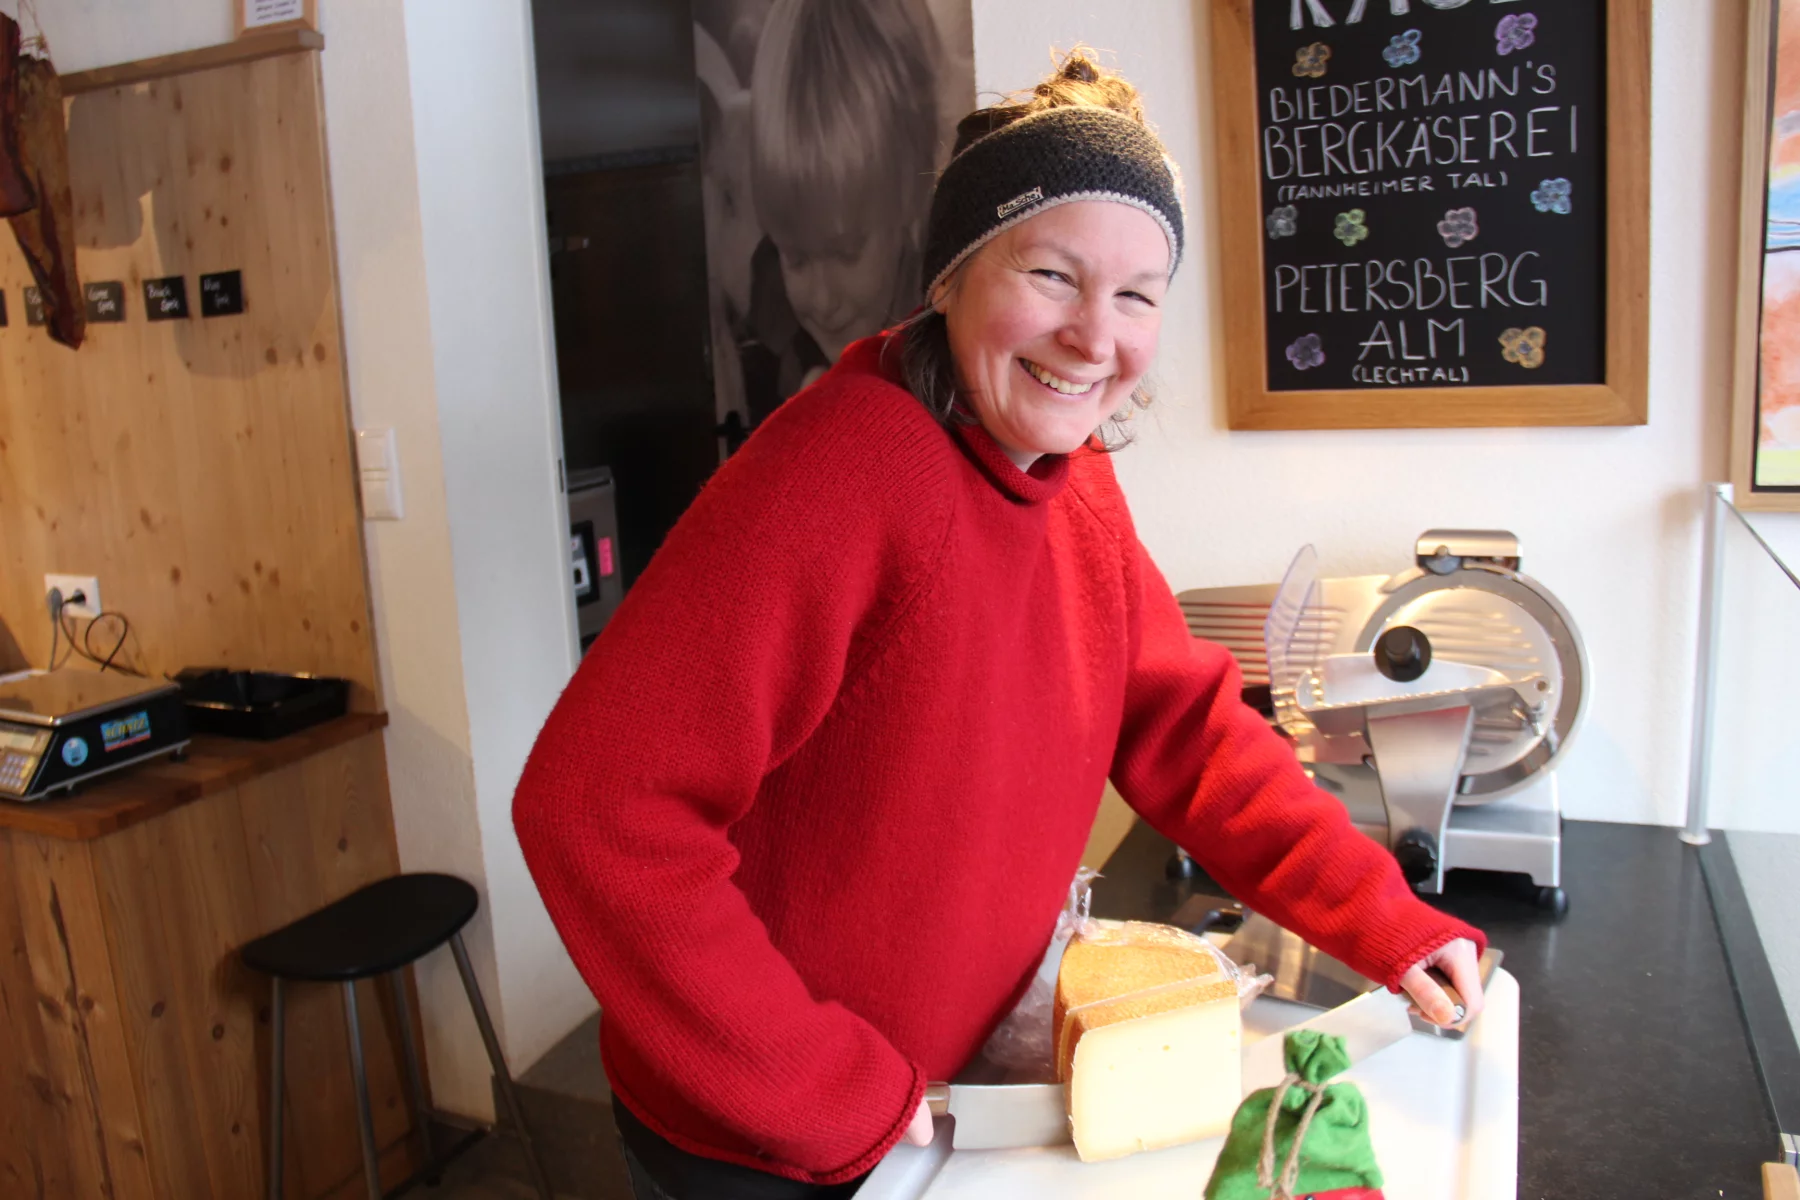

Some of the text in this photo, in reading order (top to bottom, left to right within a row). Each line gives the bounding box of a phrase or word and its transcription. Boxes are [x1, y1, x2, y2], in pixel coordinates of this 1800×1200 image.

[1269, 61, 1557, 123] BIEDERMANN'S
[1264, 105, 1578, 180] BERGKÄSEREI
[1278, 171, 1509, 202] (TANNHEIMER TAL)
[1274, 251, 1549, 313] PETERSBERG
[1358, 318, 1466, 361] ALM
[1352, 364, 1470, 385] (LECHTAL)
